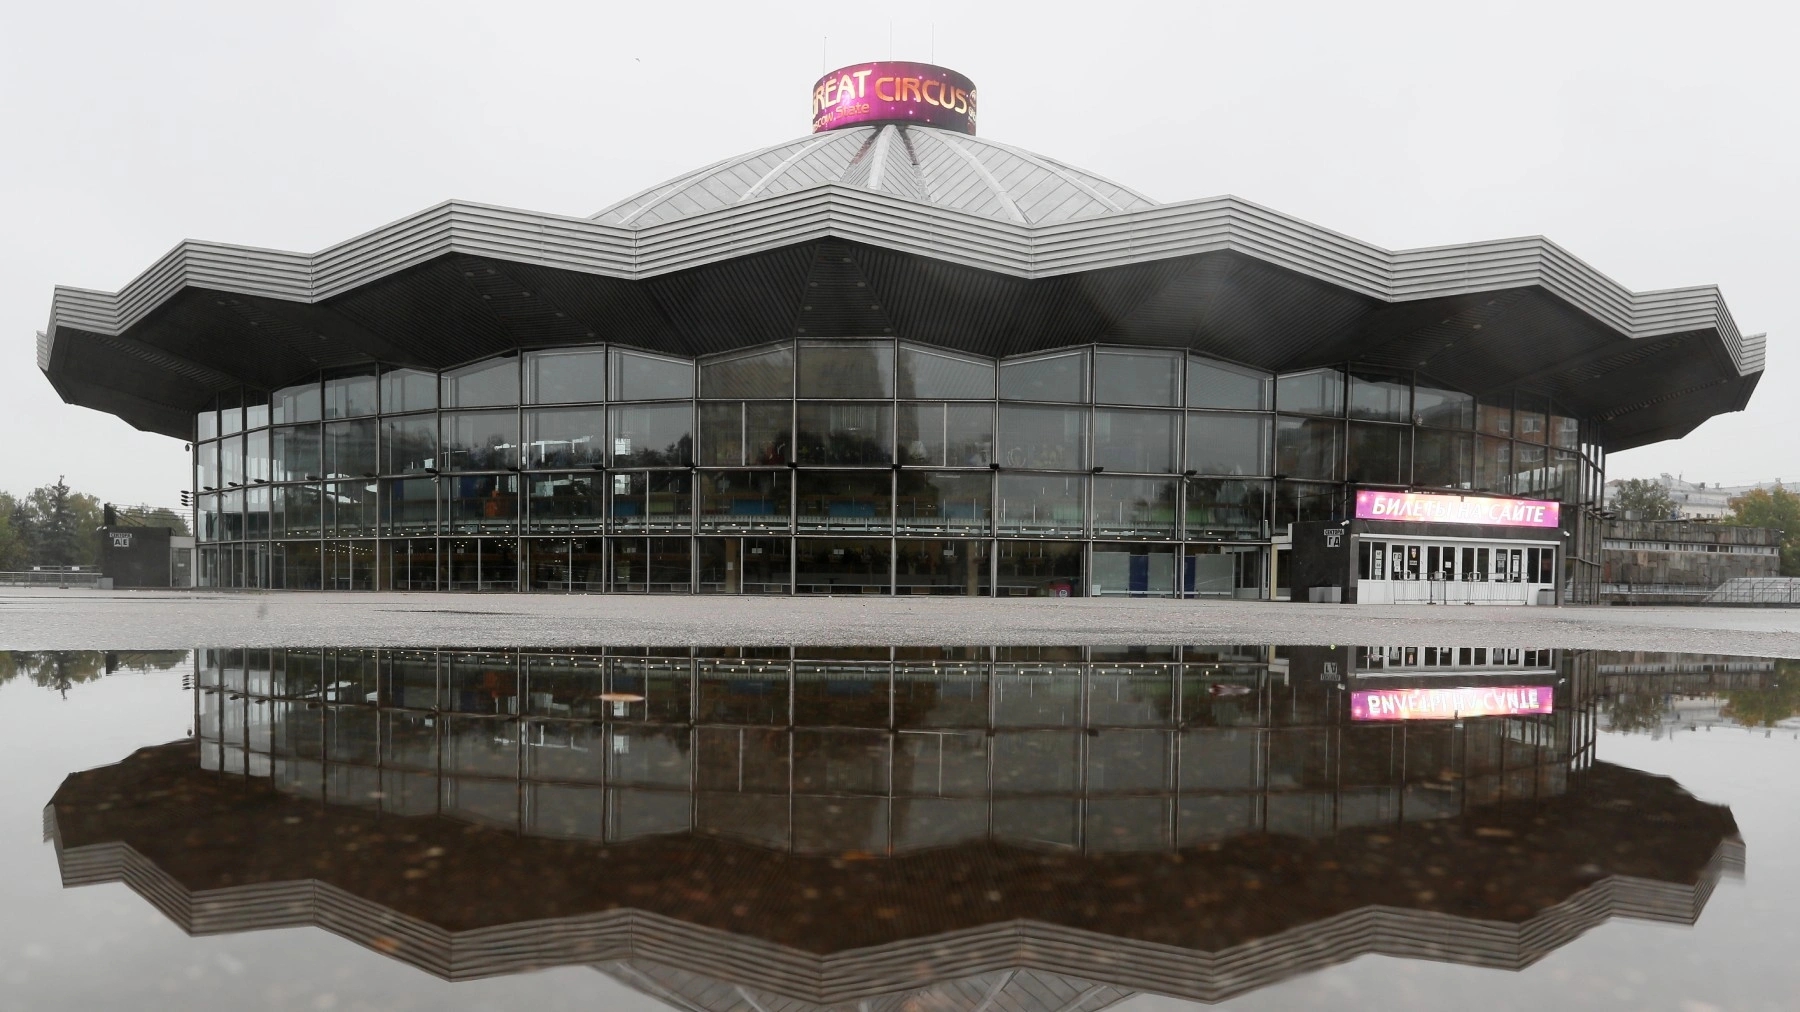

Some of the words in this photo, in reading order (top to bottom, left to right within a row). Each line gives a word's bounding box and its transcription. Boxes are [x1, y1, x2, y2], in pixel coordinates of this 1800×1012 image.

[813, 70, 872, 119] REAT
[875, 77, 967, 114] CIRCUS
[836, 102, 869, 118] State
[1372, 496, 1451, 518] БИЛЕТЫ
[1458, 502, 1484, 520] НА
[1489, 501, 1546, 523] САЙТЕ
